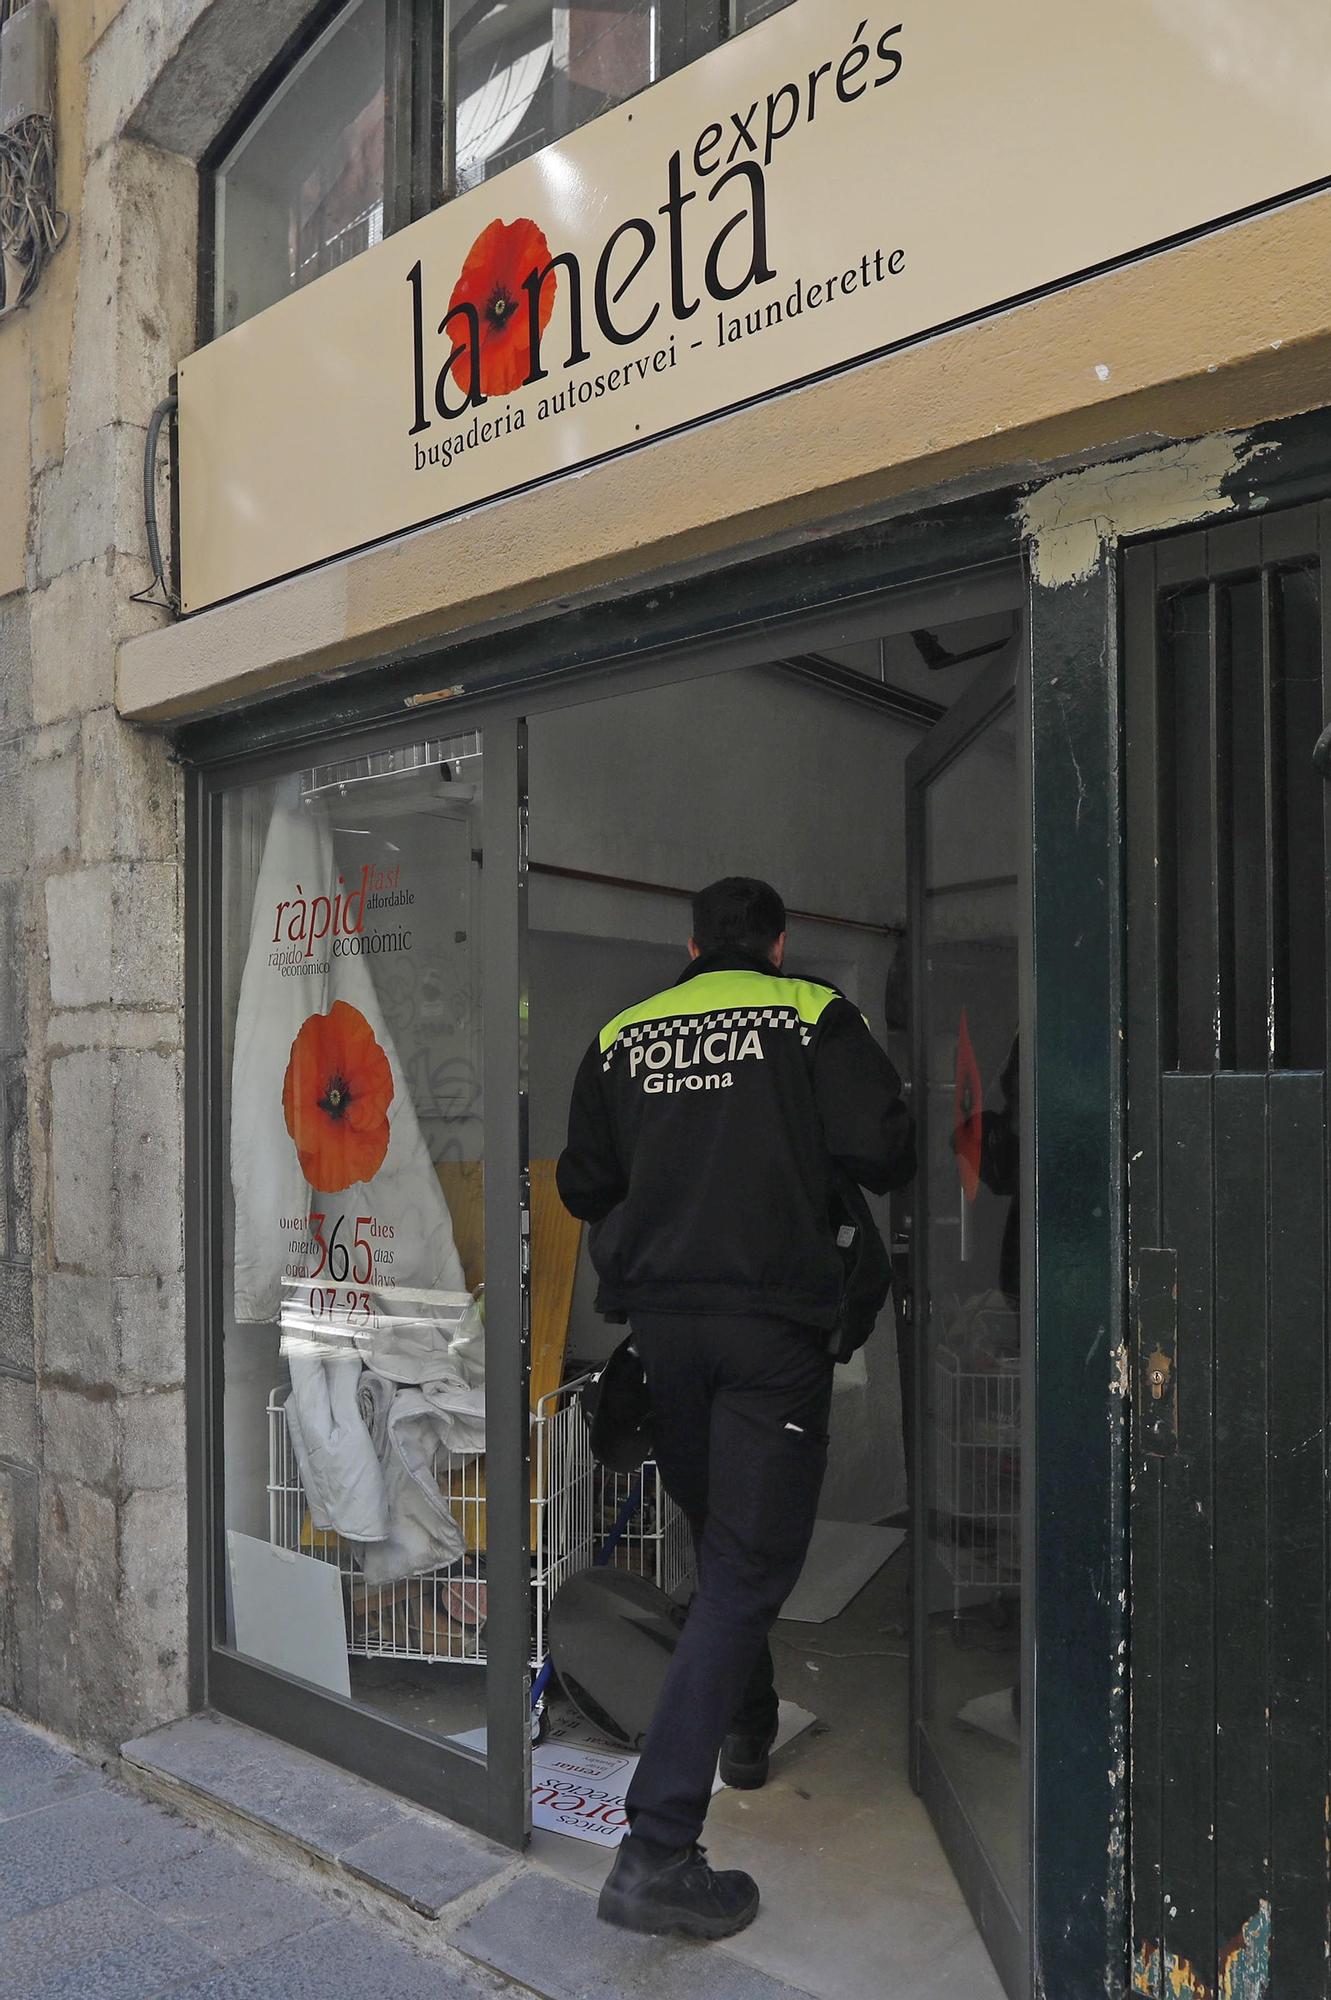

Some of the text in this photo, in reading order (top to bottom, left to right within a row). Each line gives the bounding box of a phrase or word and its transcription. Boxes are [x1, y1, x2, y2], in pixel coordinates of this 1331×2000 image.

[692, 19, 903, 178] exprés
[414, 408, 526, 471] bugaderia
[536, 335, 678, 421] autoservei
[717, 248, 906, 347] launderette
[272, 864, 369, 957] ràpid
[366, 890, 416, 910] affordable
[332, 925, 413, 957] econòmic
[268, 944, 303, 972] rápido
[629, 1030, 764, 1078] POLICIA
[643, 1072, 734, 1094] Girona
[308, 1212, 372, 1285] 365
[552, 1761, 602, 1777] rentar
[555, 1814, 619, 1836] prices
